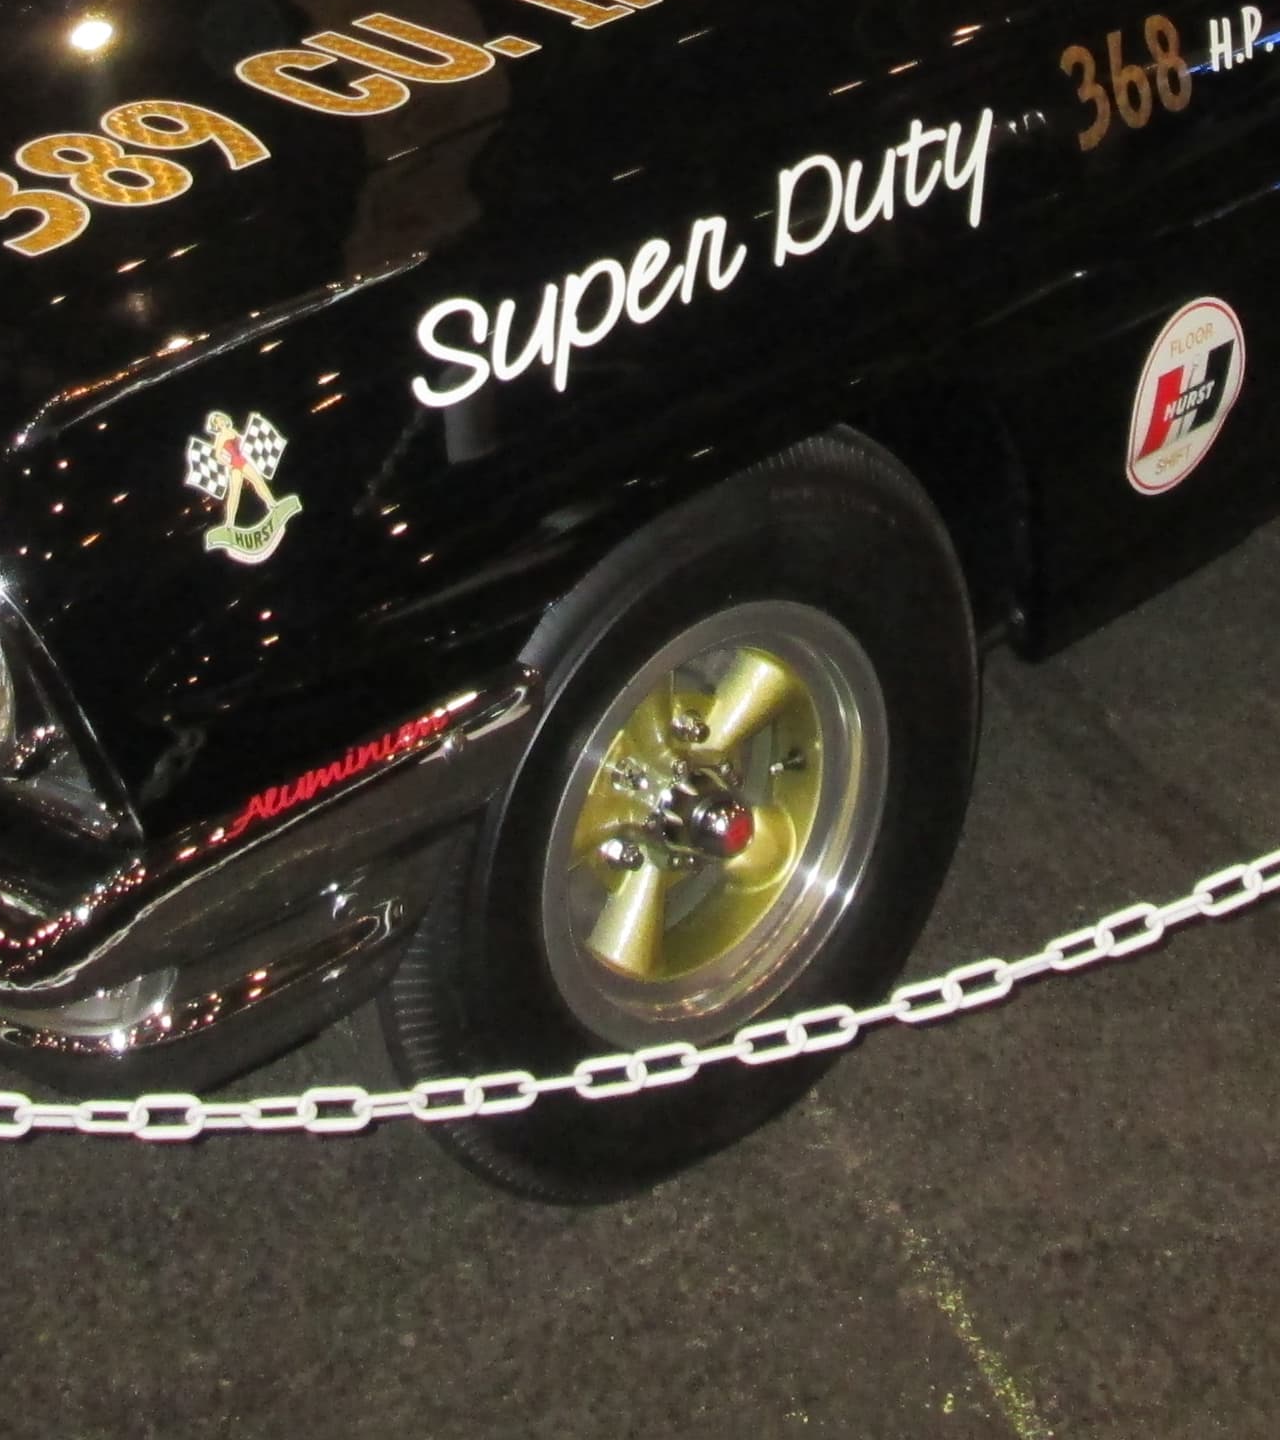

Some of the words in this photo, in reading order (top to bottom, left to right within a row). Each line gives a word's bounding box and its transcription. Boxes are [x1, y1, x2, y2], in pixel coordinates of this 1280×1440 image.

[235, 12, 543, 116] CU.
[1059, 14, 1193, 152] 368
[1209, 6, 1275, 73] H.P.
[412, 215, 748, 408] Super
[774, 107, 994, 267] Duty
[1170, 322, 1216, 359] FLOOR
[1164, 380, 1216, 422] HURST
[1155, 443, 1192, 476] SHIFT
[234, 518, 275, 549] HURST
